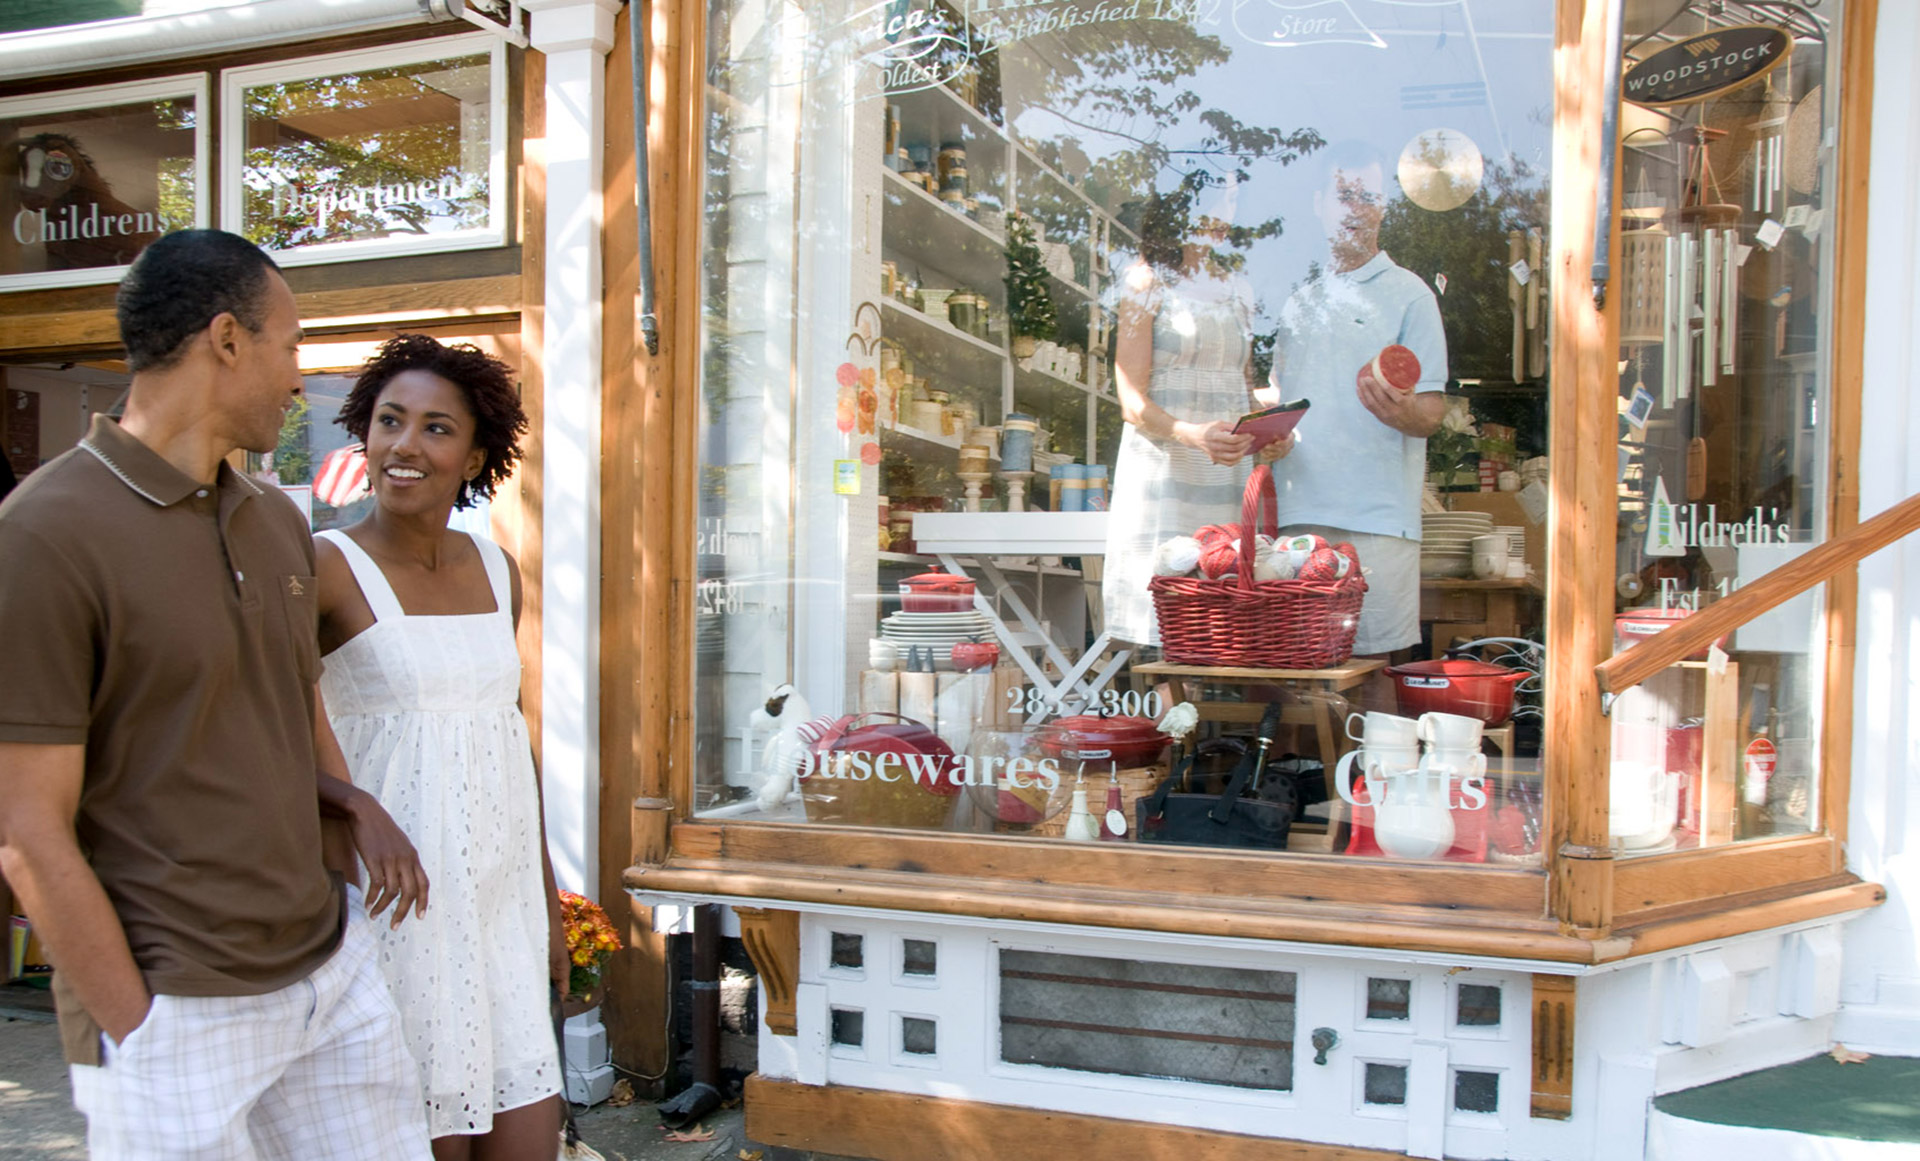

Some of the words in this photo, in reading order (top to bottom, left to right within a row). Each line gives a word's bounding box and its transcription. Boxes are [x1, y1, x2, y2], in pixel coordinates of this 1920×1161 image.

[978, 0, 1140, 55] Established
[1148, 0, 1222, 26] 1842
[1273, 14, 1337, 39] Store
[876, 61, 942, 90] Oldest
[1628, 42, 1773, 91] WOODSTOCK
[13, 202, 170, 245] Childrens
